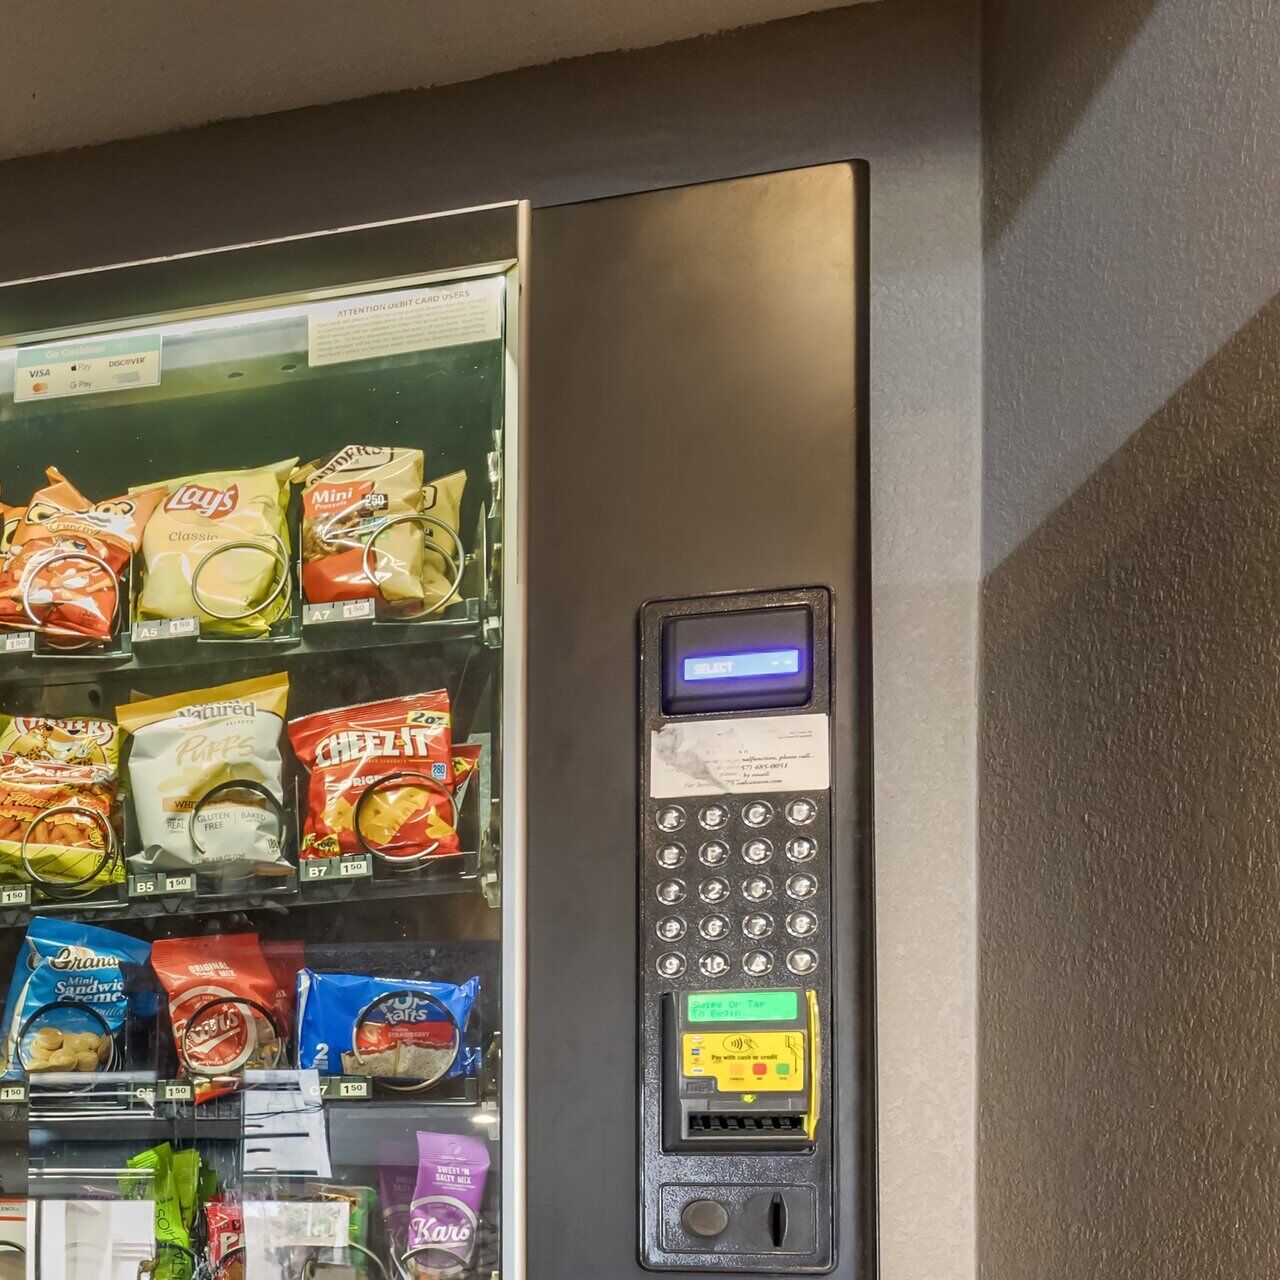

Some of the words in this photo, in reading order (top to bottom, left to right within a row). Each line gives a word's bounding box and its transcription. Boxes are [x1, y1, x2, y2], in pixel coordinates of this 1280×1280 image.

[337, 303, 386, 318] ATTENTION
[388, 299, 414, 310] DEBIT
[415, 295, 440, 306] CARD
[441, 289, 471, 301] USERS
[78, 363, 92, 372] Pay
[108, 356, 146, 368] DISCOVER
[29, 368, 51, 378] VISA
[78, 380, 92, 389] Pay
[164, 484, 237, 517] Lay's
[312, 487, 353, 503] Mini
[365, 493, 385, 507] 250
[312, 611, 331, 621] A7
[140, 628, 158, 638] A5
[693, 661, 734, 676] SELECT
[178, 701, 256, 720] Natured
[411, 713, 424, 723] 2
[315, 726, 440, 768] CHEEZ-IT
[432, 763, 445, 775] 280
[197, 811, 230, 824] GLUTEN
[241, 811, 266, 821] BAKED
[663, 813, 677, 826] A
[748, 807, 764, 823] C
[167, 821, 185, 829] REAL
[204, 822, 224, 832] FREE
[309, 866, 328, 877] B7
[136, 882, 155, 892] B5
[708, 884, 721, 899] 2
[666, 921, 679, 937] 5
[708, 920, 721, 936] 6
[751, 919, 765, 934] 7
[795, 918, 808, 933] 8
[665, 957, 679, 973] 9
[706, 957, 725, 973] 10
[66, 975, 95, 986] Mini
[692, 1000, 723, 1009] Swipe
[728, 1000, 740, 1008] Or
[747, 999, 766, 1008] Tap
[385, 1007, 429, 1025] tarts
[711, 1009, 742, 1018] Begin
[315, 1043, 329, 1060] 2
[437, 1165, 460, 1175] SWEET
[435, 1174, 455, 1183] SALTY
[457, 1175, 472, 1185] MIX
